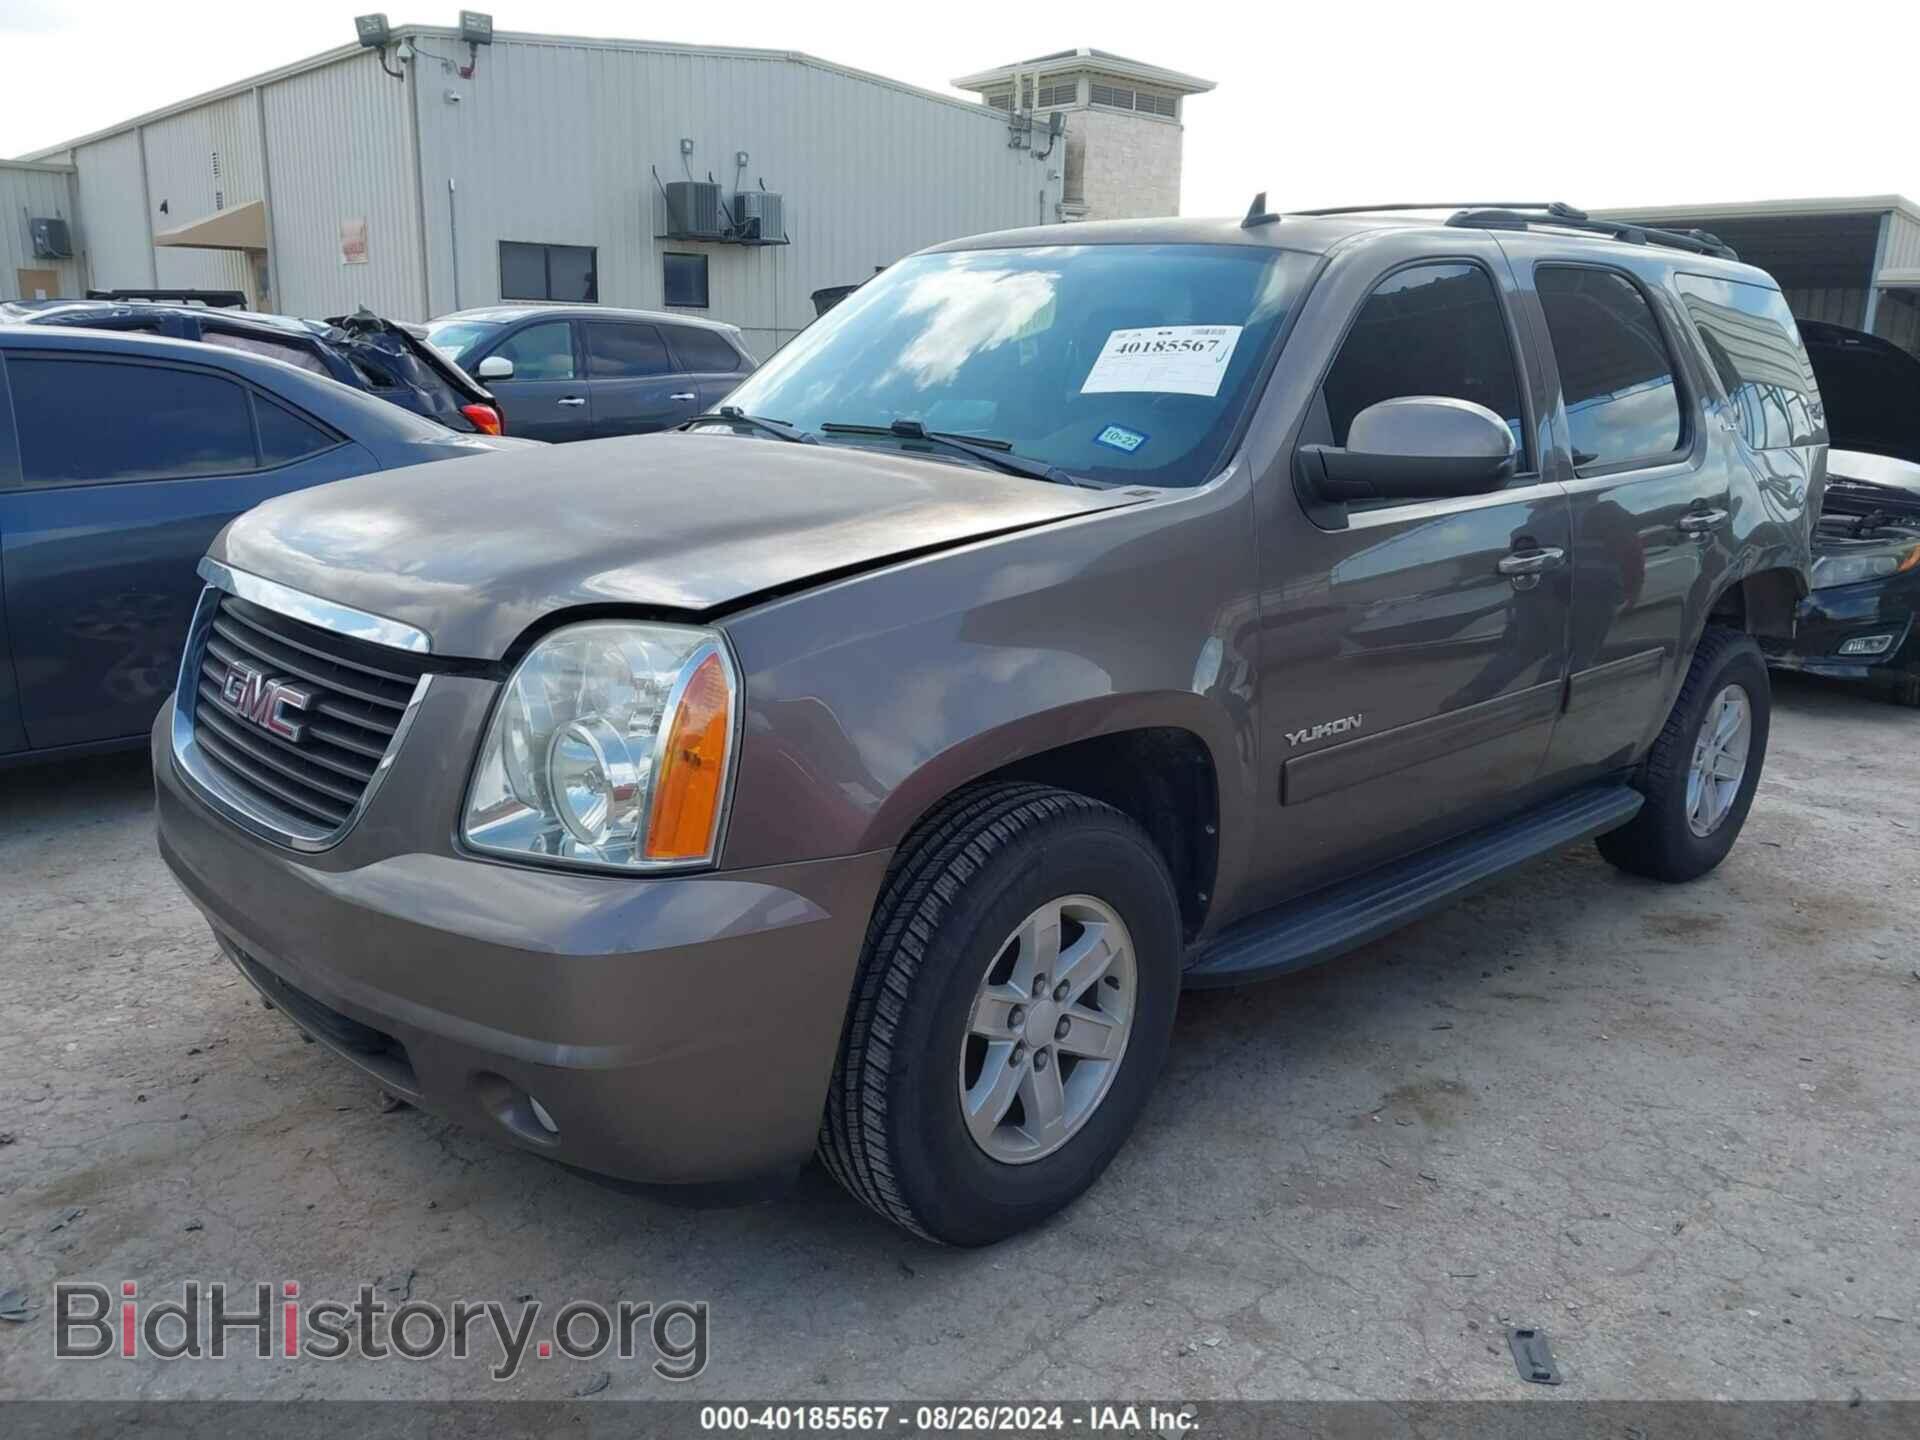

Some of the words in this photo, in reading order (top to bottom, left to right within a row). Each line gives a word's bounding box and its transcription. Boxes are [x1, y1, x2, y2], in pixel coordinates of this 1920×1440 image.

[1115, 339, 1220, 354] 40185567
[221, 661, 311, 742] GMC
[1285, 713, 1363, 747] YUKON
